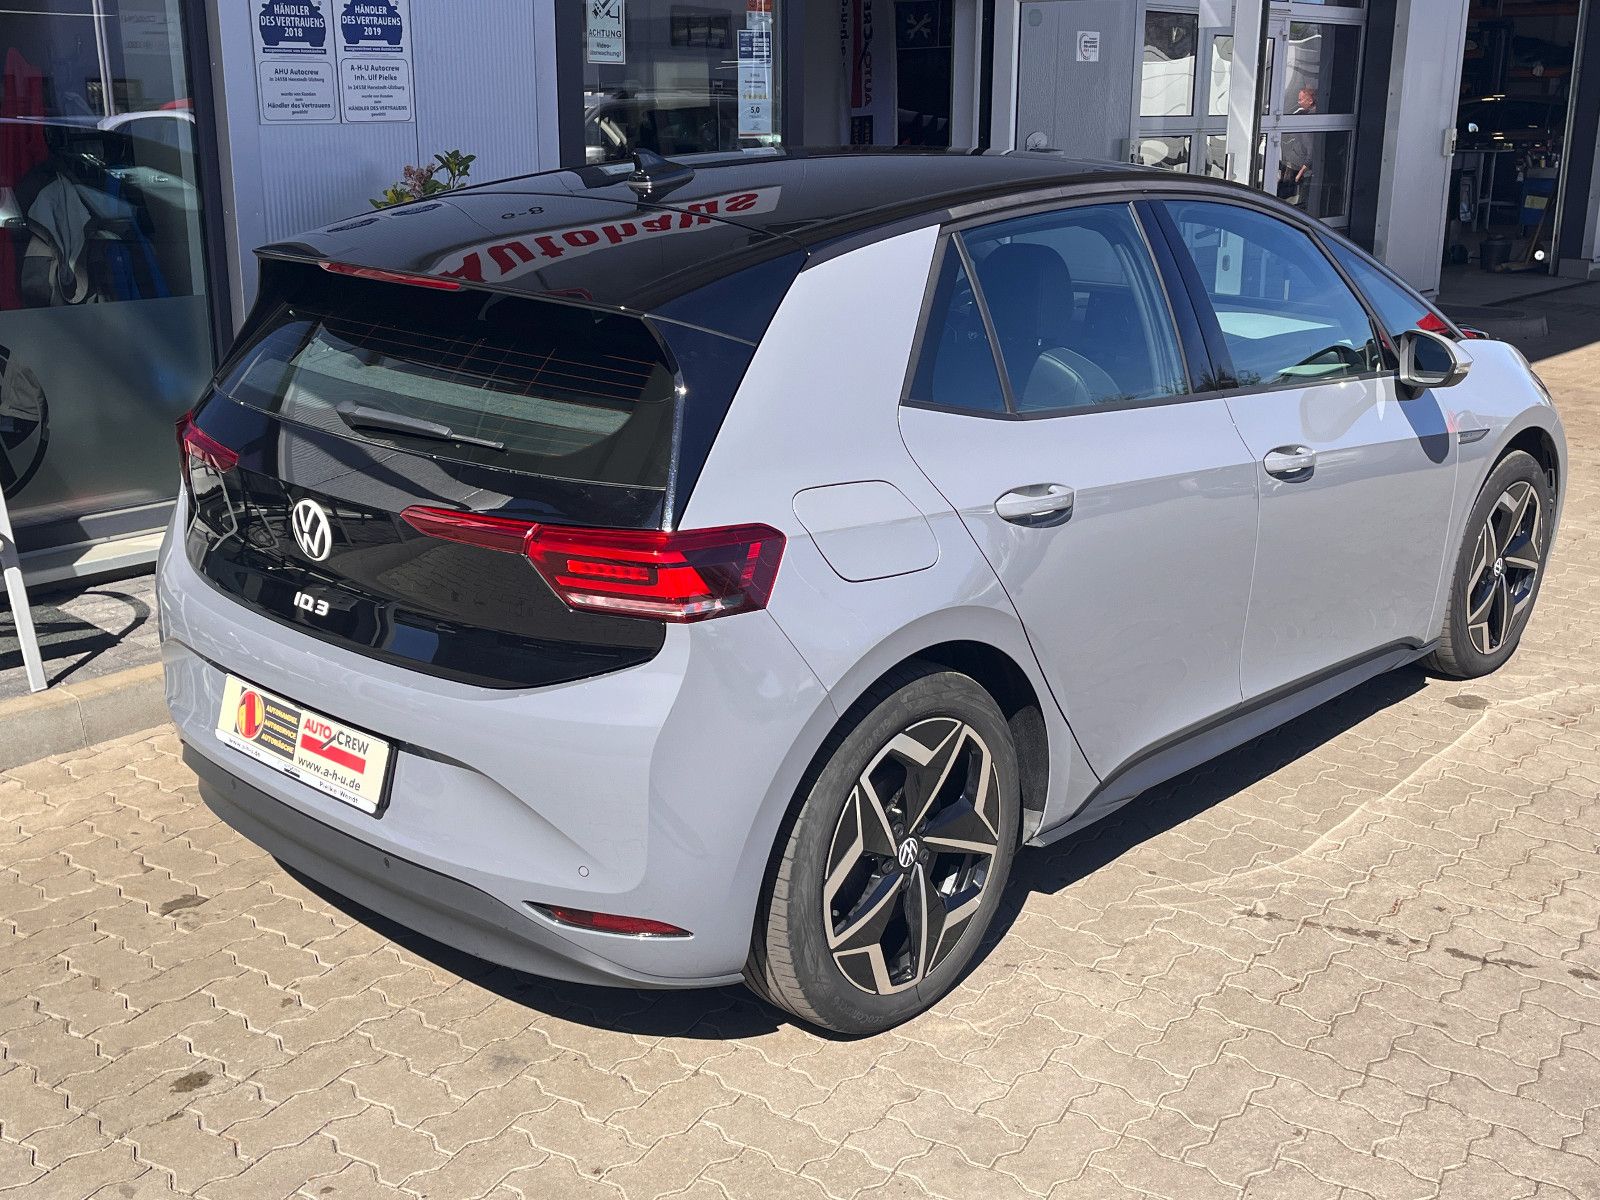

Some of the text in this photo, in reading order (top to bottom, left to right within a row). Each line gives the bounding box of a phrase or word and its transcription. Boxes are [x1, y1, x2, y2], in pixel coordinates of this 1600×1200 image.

[273, 3, 310, 16] HÄNDLER
[354, 4, 388, 15] HÄNDLER
[260, 15, 325, 28] DES VERTRAUENS
[341, 15, 401, 26] DES VERTRAUENS
[284, 27, 303, 37] 2018
[363, 27, 381, 36] 2019
[589, 29, 622, 38] ACHTUNG
[350, 64, 370, 72] A-H-U
[304, 718, 370, 756] AUTO CREW
[298, 756, 362, 792] www.a-h-u.de
